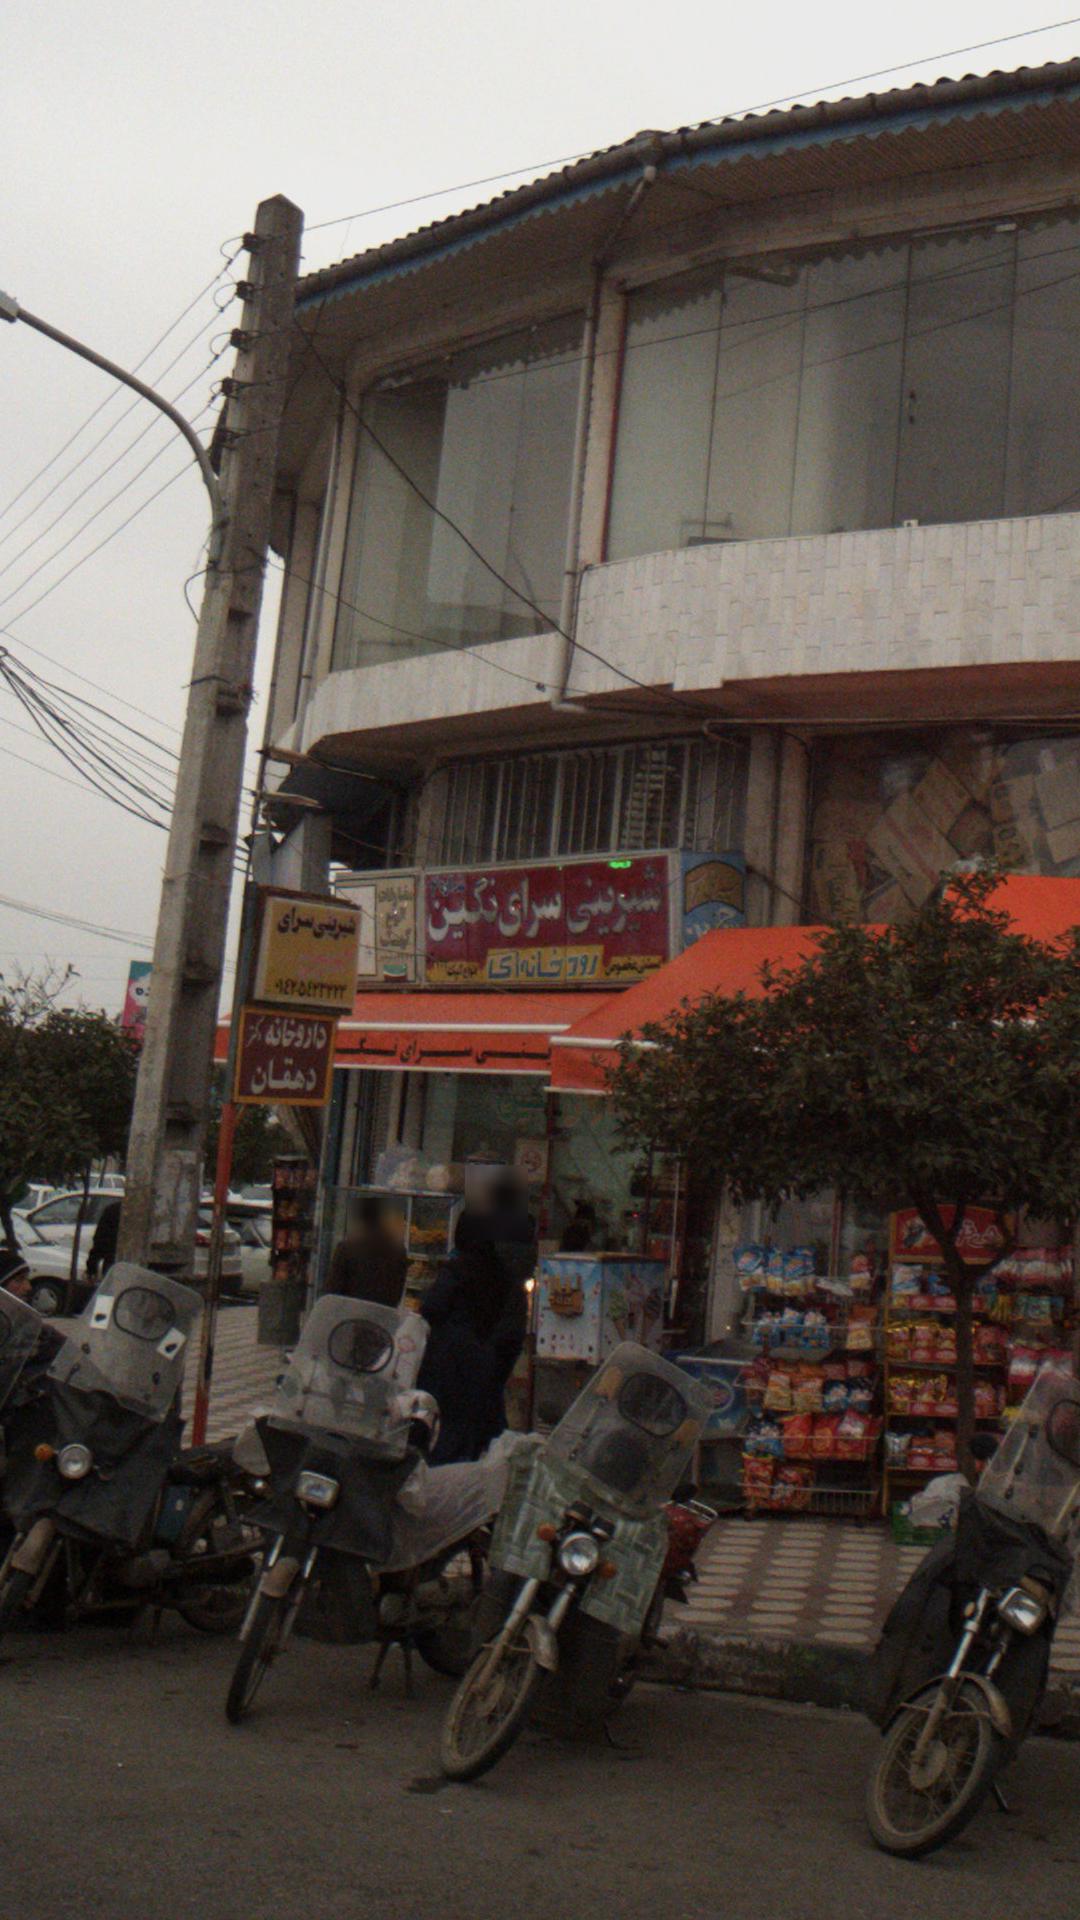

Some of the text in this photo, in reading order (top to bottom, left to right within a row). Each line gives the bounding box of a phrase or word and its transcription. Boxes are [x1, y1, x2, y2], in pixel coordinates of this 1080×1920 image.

[277, 907, 356, 940] شیرینی سرای
[428, 877, 499, 942] نگین
[498, 878, 563, 938] سرای
[567, 865, 662, 935] شیرینی
[265, 1017, 328, 1050] داروخانه
[250, 1055, 318, 1095] دهقان
